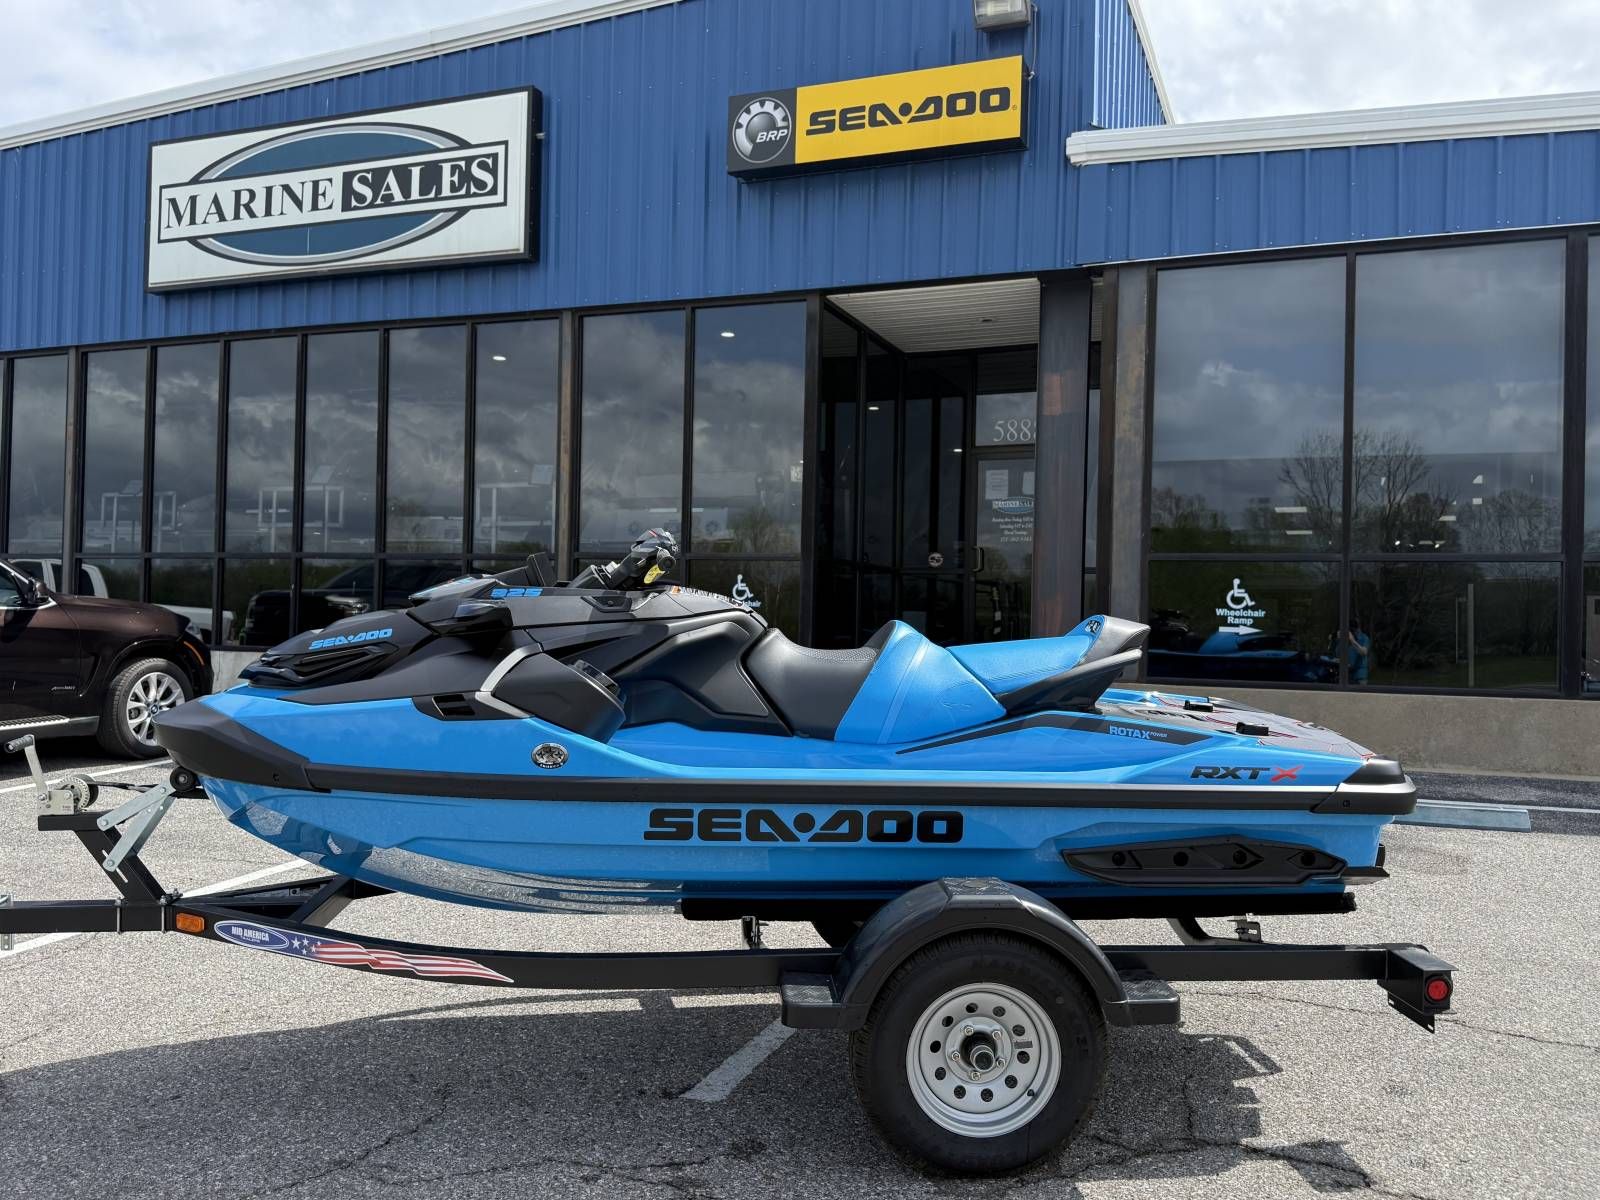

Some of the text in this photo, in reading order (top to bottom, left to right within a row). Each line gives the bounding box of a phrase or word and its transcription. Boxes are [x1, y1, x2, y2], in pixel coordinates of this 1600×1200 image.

[756, 128, 788, 142] BRP
[164, 156, 494, 229] MARINE SALES
[993, 419, 1036, 441] 588
[1215, 608, 1266, 617] Wheelchair
[1227, 616, 1254, 626] Ramp
[1109, 725, 1150, 739] ROTAX
[231, 926, 270, 941] MID AMERICA
